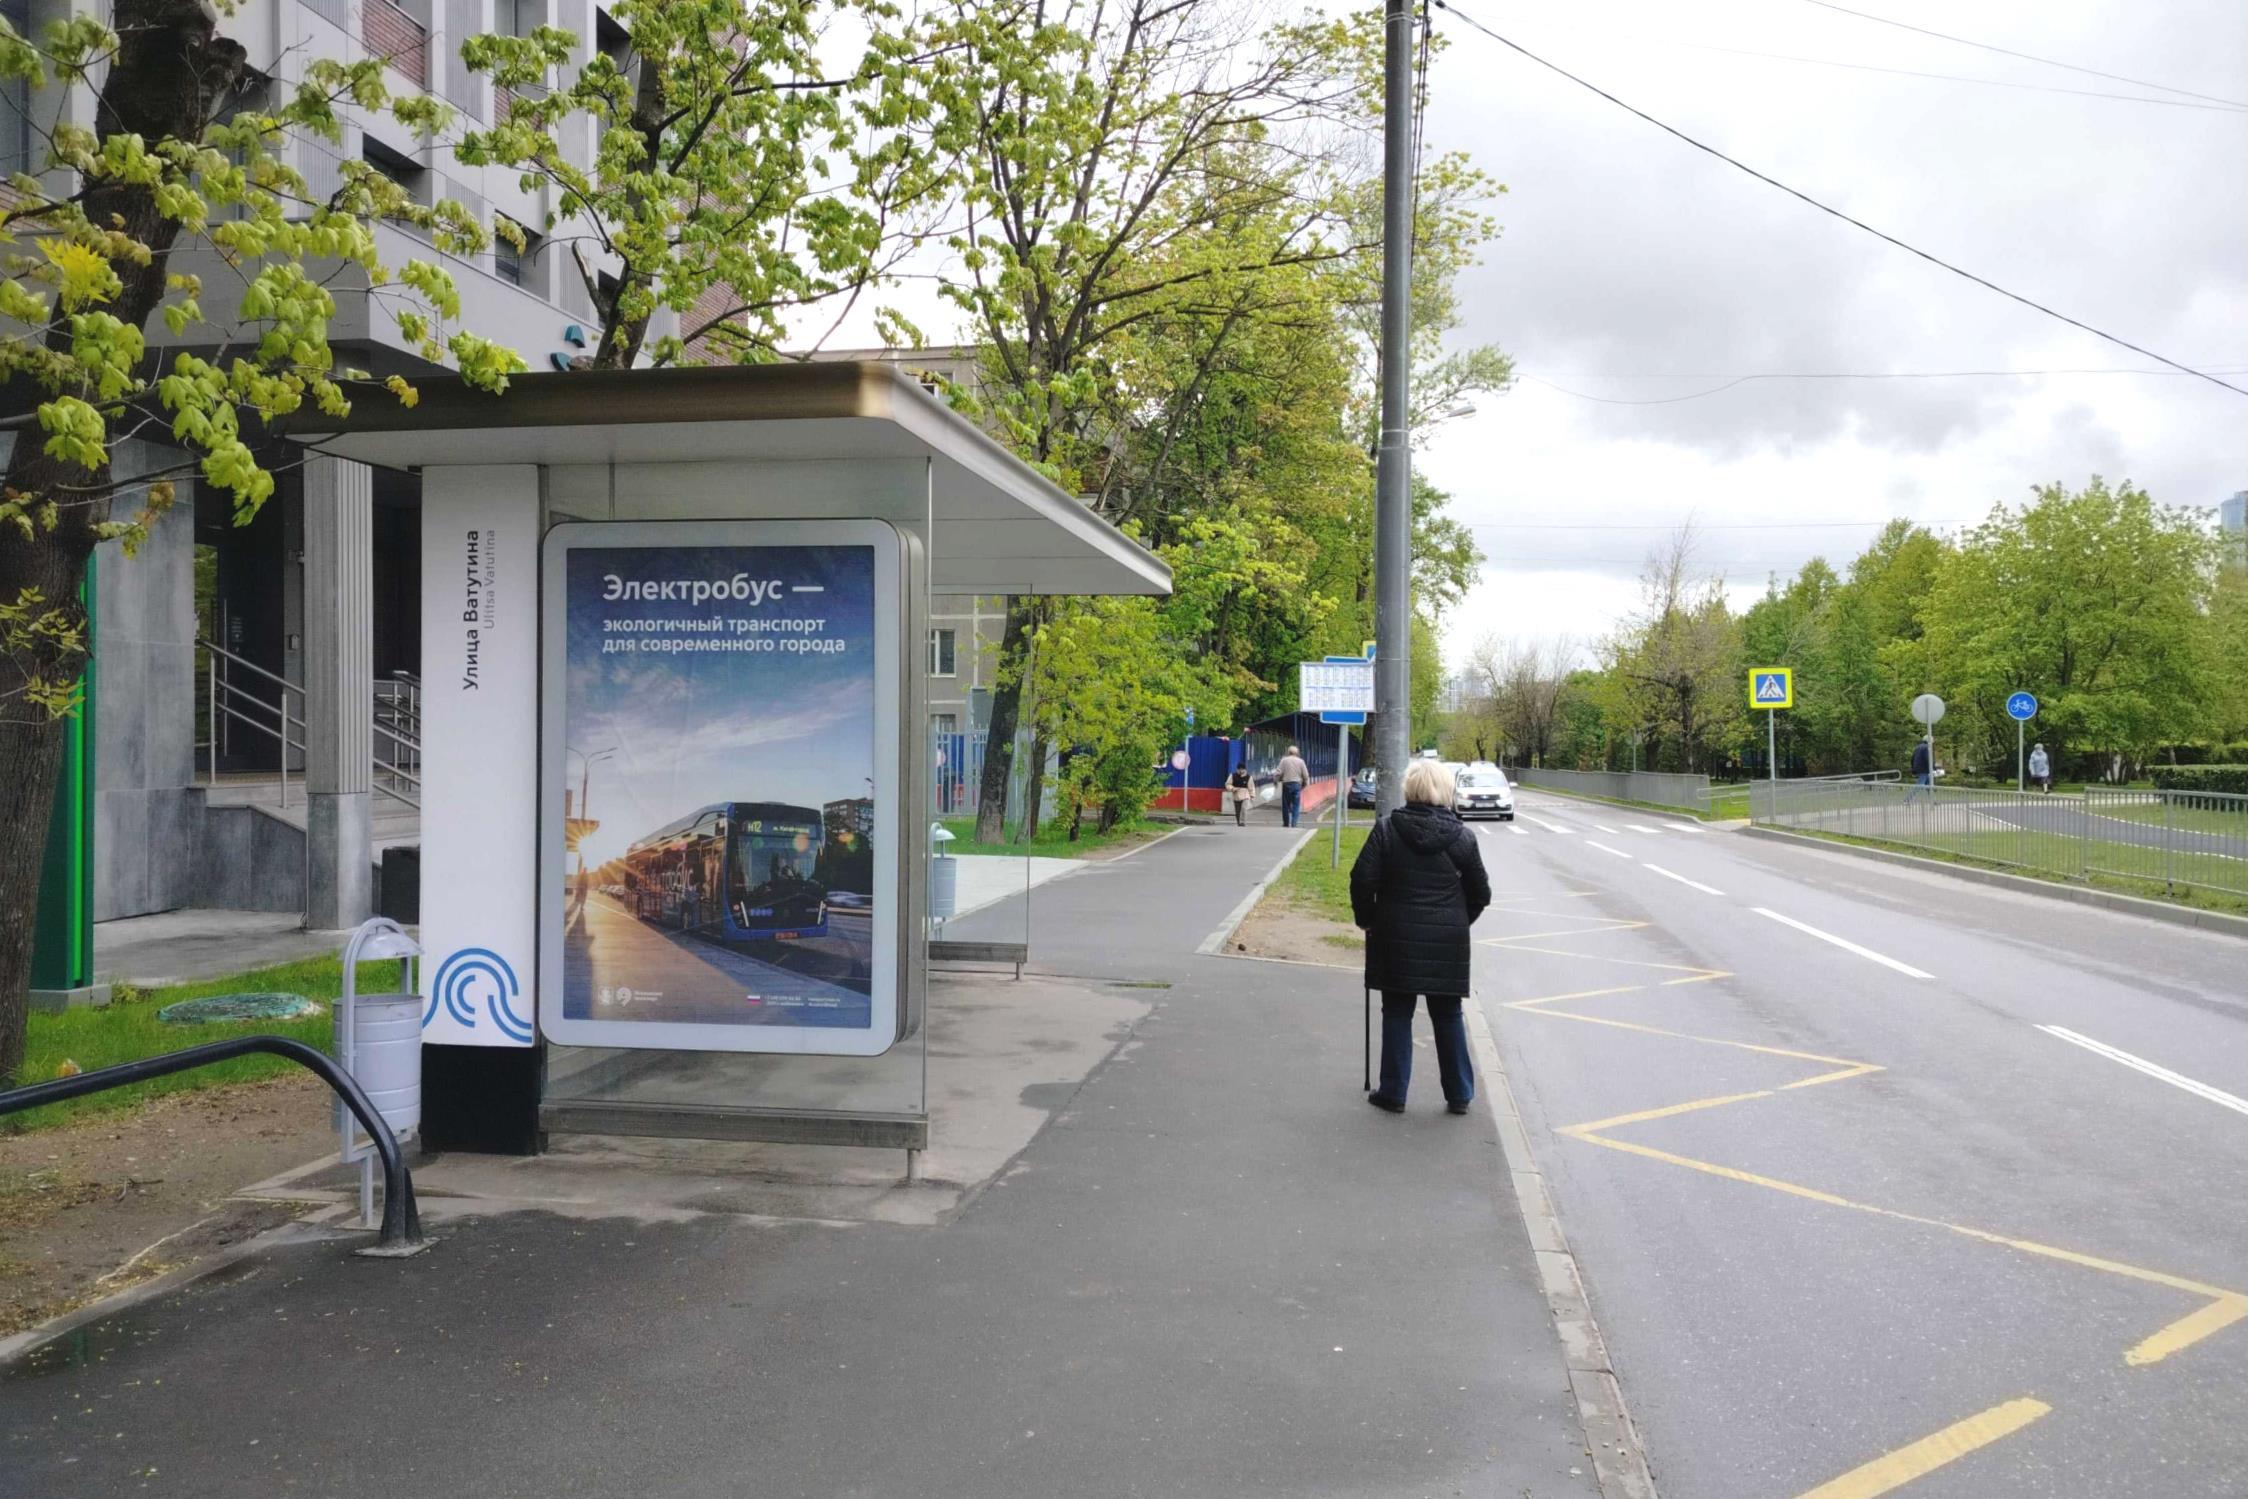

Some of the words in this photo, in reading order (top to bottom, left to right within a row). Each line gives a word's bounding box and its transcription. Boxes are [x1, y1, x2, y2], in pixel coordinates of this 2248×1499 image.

[463, 530, 482, 622] Ватутина
[484, 530, 495, 586] Vatutina
[602, 573, 783, 606] Электробус
[484, 590, 495, 629] Ulitsa
[602, 615, 723, 632] экологичный
[728, 618, 825, 635] транспорт
[463, 628, 480, 690] Улица
[602, 638, 636, 653] для
[640, 638, 774, 655] современного
[779, 638, 845, 654] города
